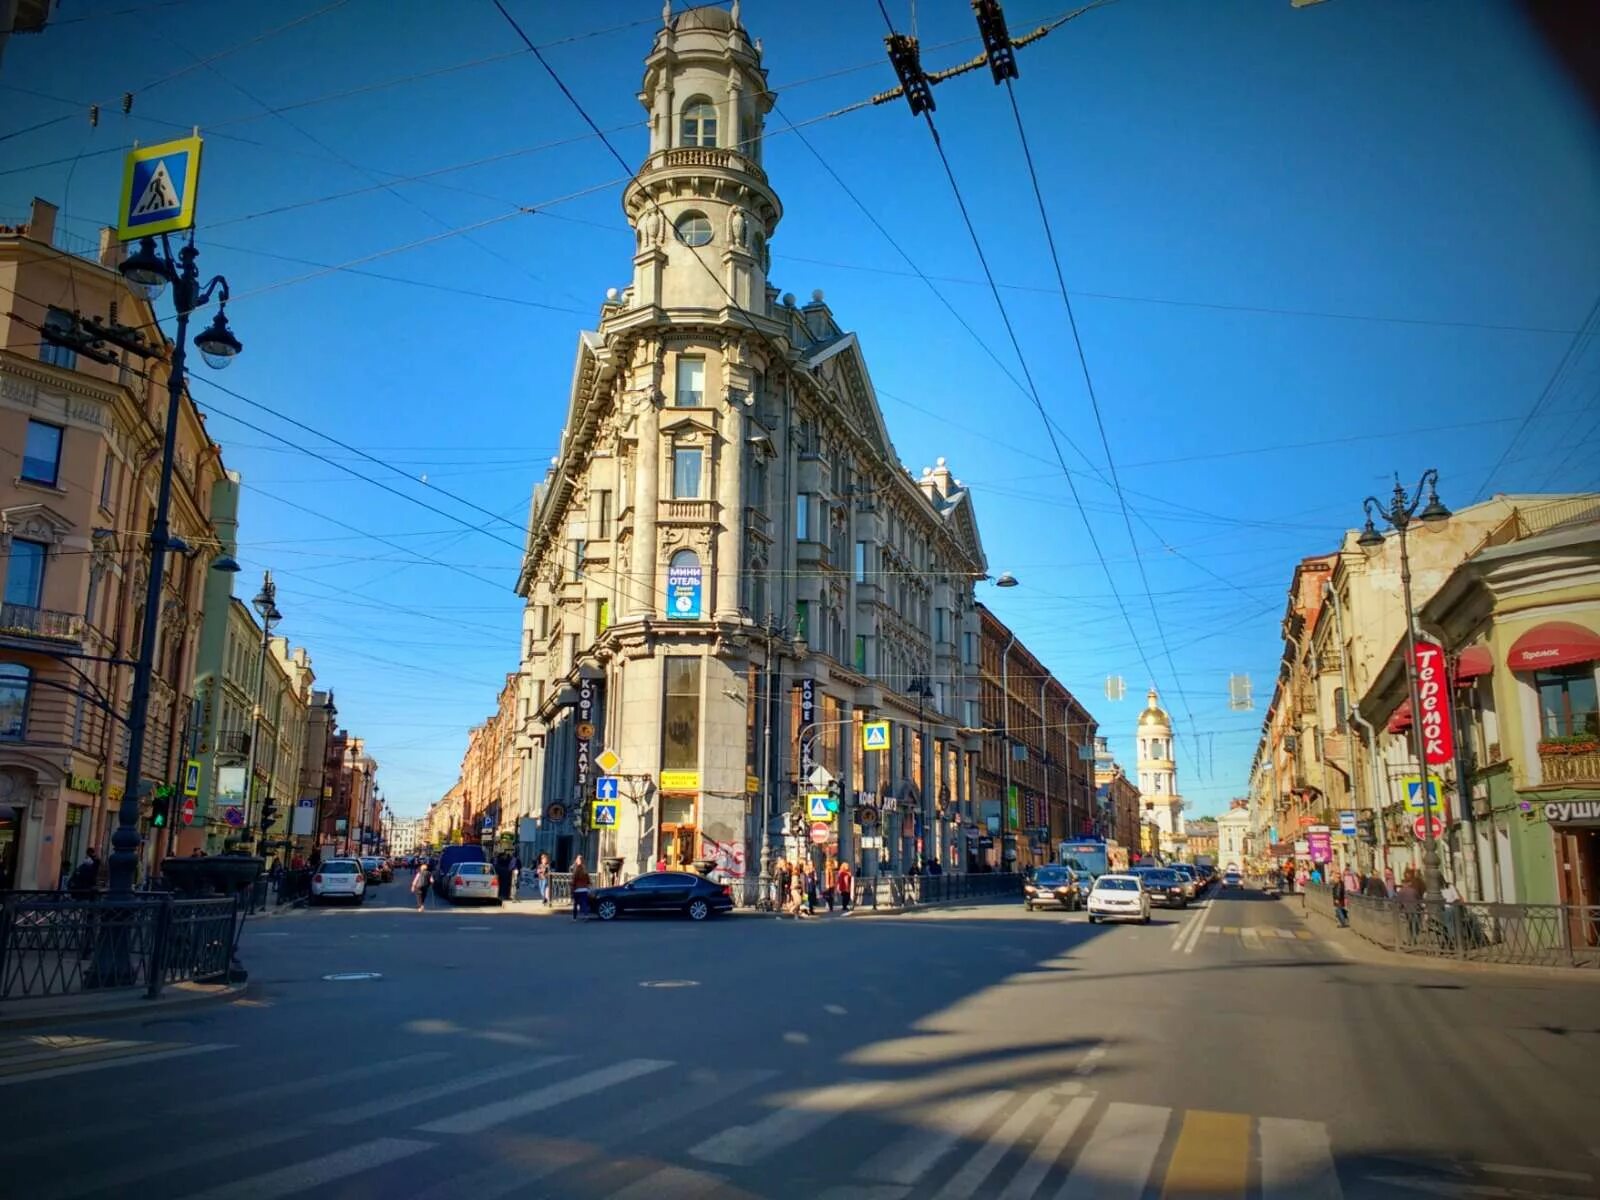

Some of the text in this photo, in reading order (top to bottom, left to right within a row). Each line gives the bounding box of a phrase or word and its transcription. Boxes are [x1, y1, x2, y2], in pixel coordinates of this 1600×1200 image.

[669, 577, 701, 586] ОТЕЛЬ
[670, 567, 701, 576] МИНИ
[1521, 648, 1560, 661] Теремок
[802, 679, 813, 721] КОФЕ
[1416, 649, 1444, 756] Теремок
[578, 678, 591, 784] КОФЕ ХАУЗ
